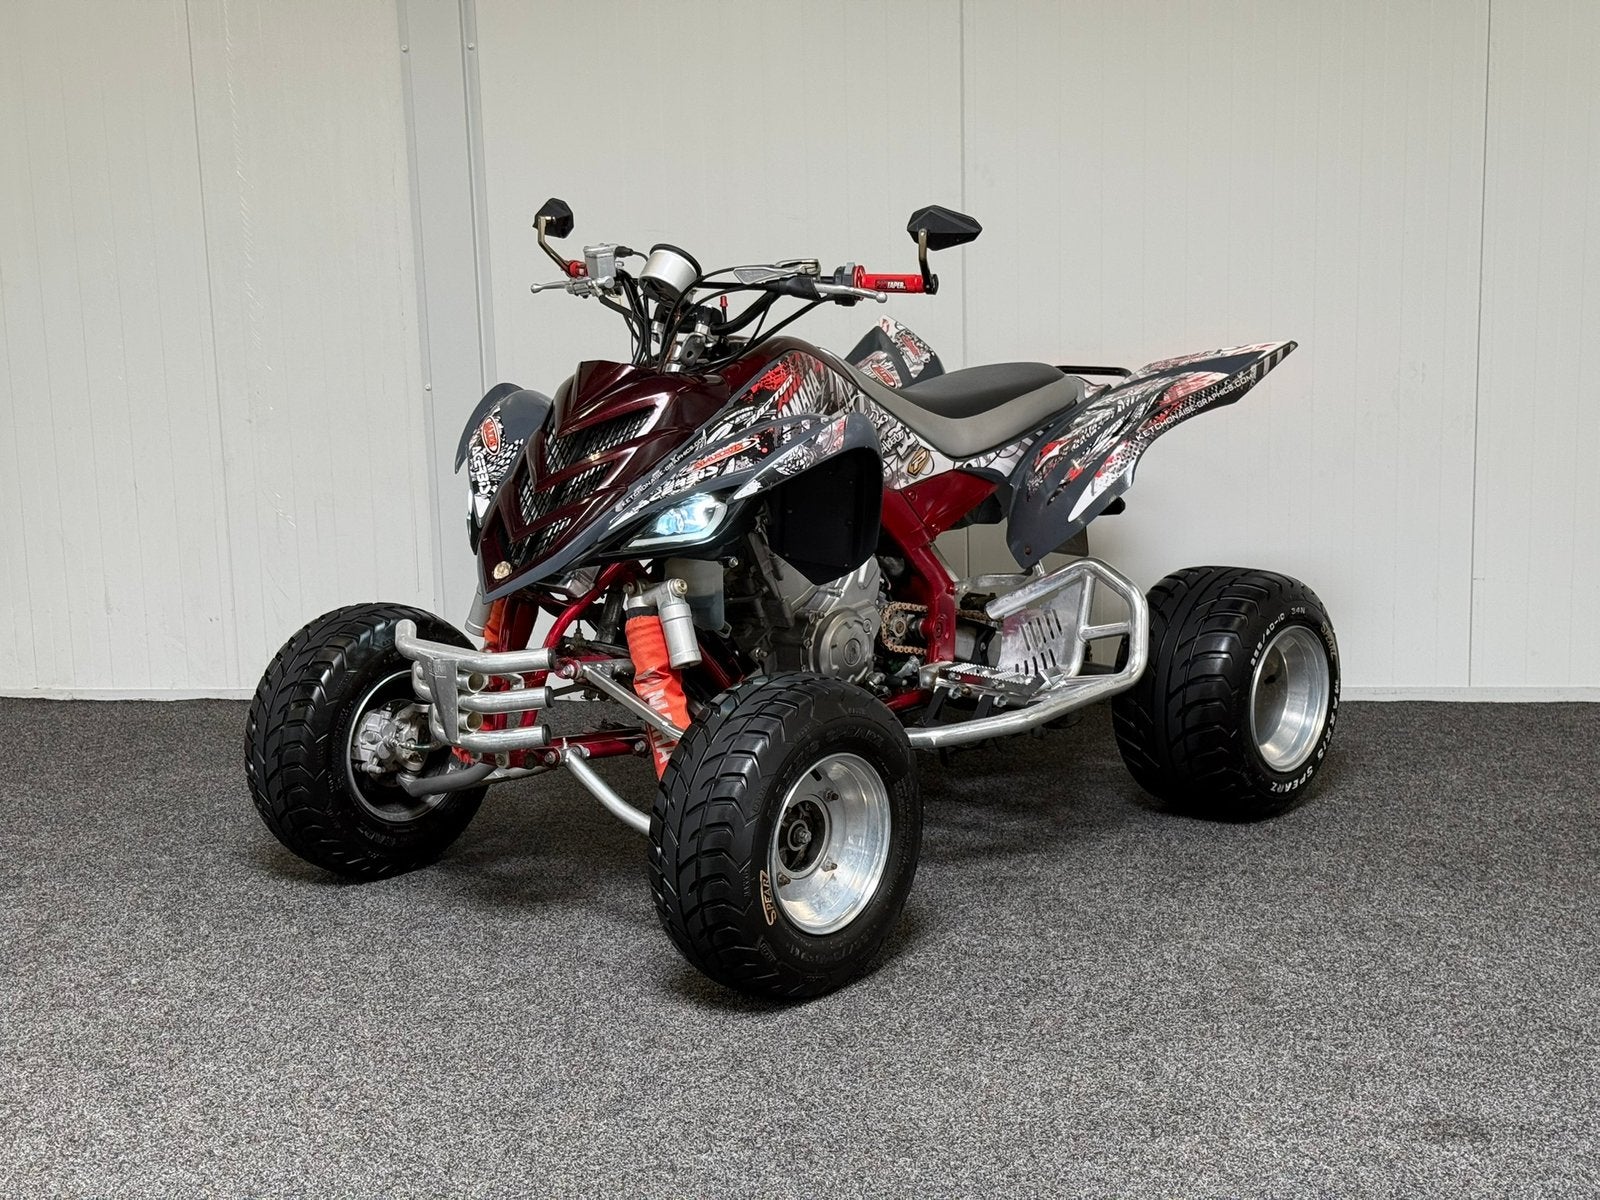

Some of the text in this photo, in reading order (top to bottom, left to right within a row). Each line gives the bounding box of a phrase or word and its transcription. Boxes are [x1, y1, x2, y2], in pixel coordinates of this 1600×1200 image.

[743, 374, 793, 428] RAPTOR
[1135, 374, 1254, 442] KETCHONAISE-GRAPHICS.COM
[1291, 607, 1306, 615] 34N
[1317, 679, 1339, 761] MAXXIS
[1270, 766, 1313, 794] SPEARZ
